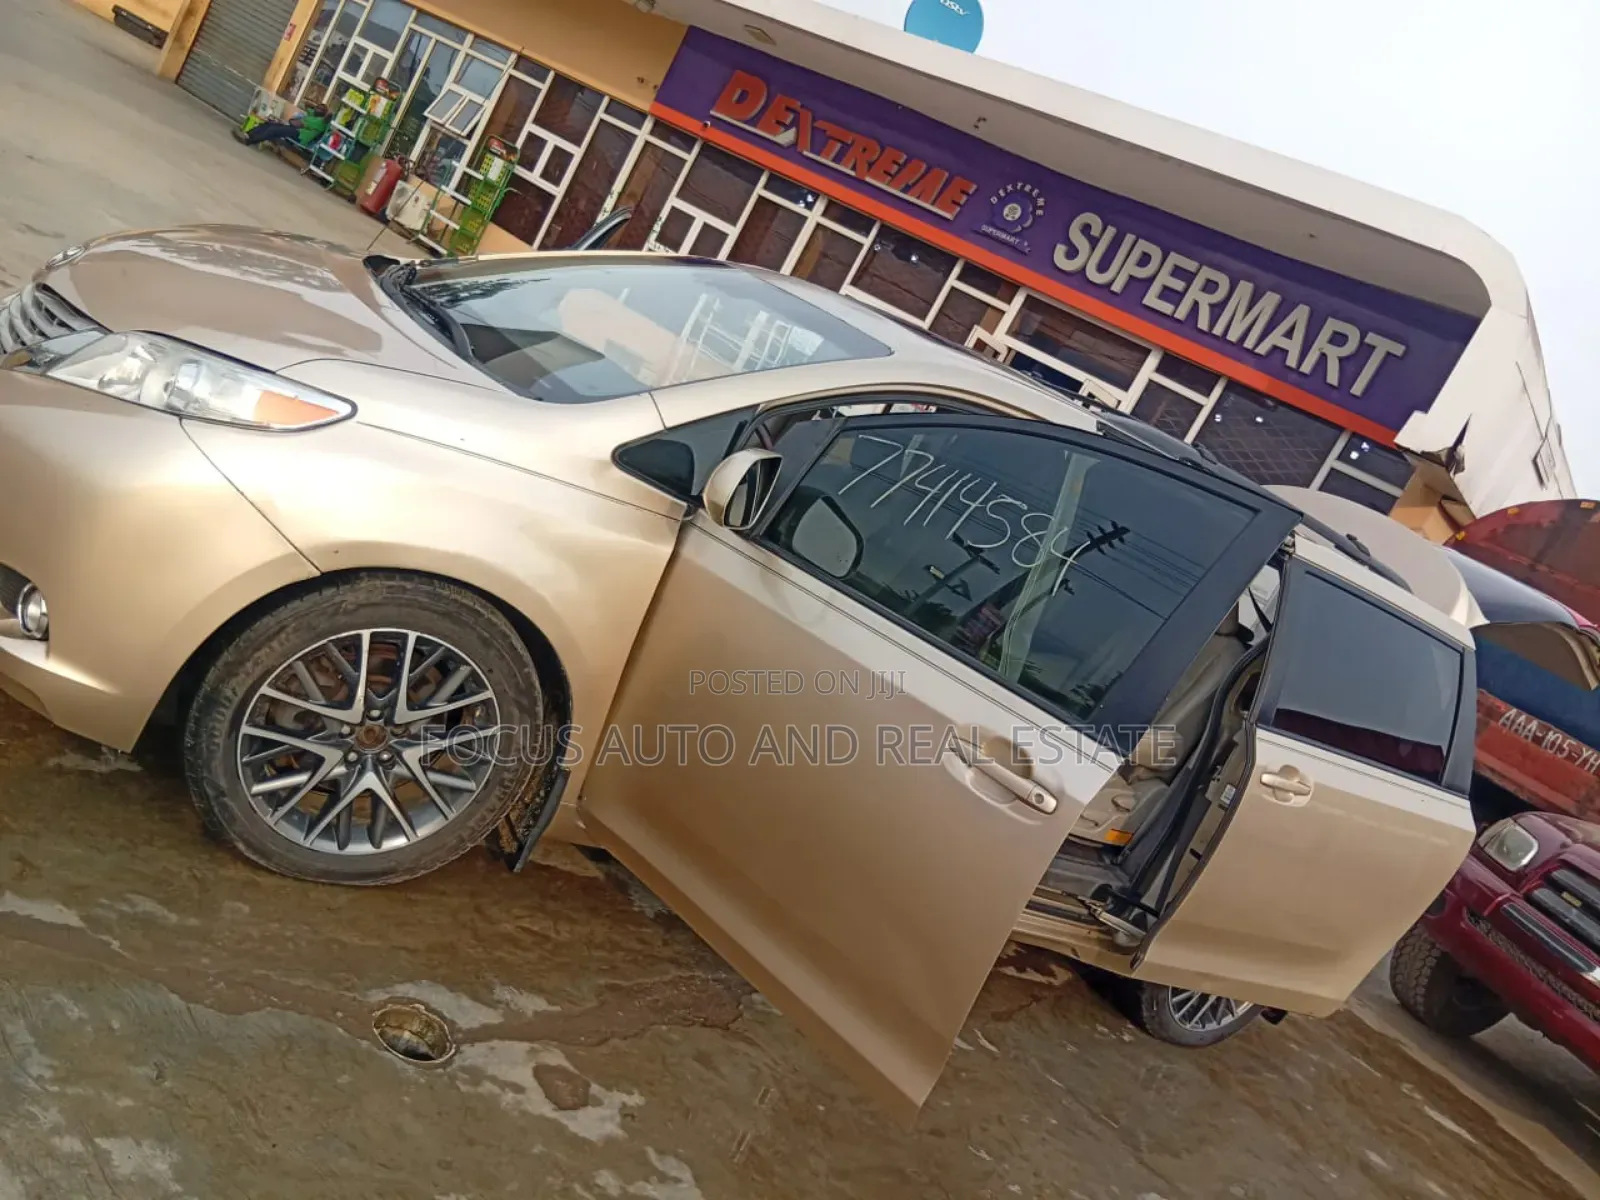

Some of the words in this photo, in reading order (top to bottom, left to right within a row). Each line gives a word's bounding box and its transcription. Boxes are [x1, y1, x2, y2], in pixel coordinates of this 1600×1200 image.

[709, 69, 977, 221] DEXTREME
[1053, 211, 1406, 399] SUPERMART
[990, 181, 1046, 216] DEXTREME
